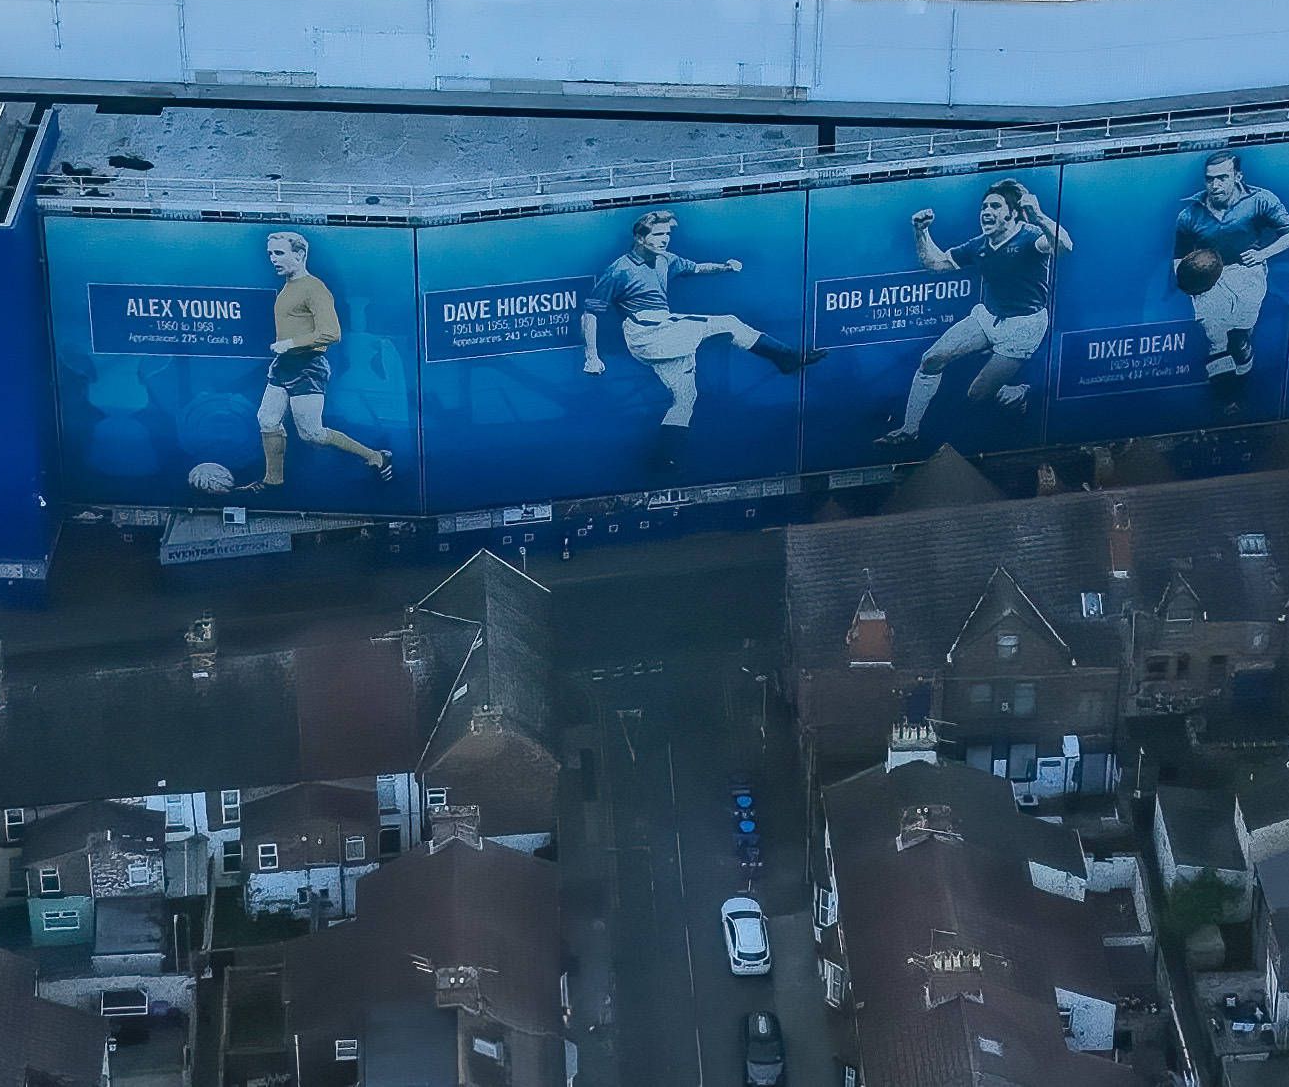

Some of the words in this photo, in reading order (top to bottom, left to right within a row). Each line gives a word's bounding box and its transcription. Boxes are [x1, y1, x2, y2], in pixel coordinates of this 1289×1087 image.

[127, 298, 173, 318] ALEX
[177, 299, 242, 319] YOUNG
[443, 299, 491, 322] DAVE
[497, 291, 577, 317] HICKSON
[826, 290, 862, 311] BOB
[869, 279, 971, 307] LATCHFORD
[1088, 338, 1134, 360] DIXIE
[1139, 332, 1186, 355] DEAN
